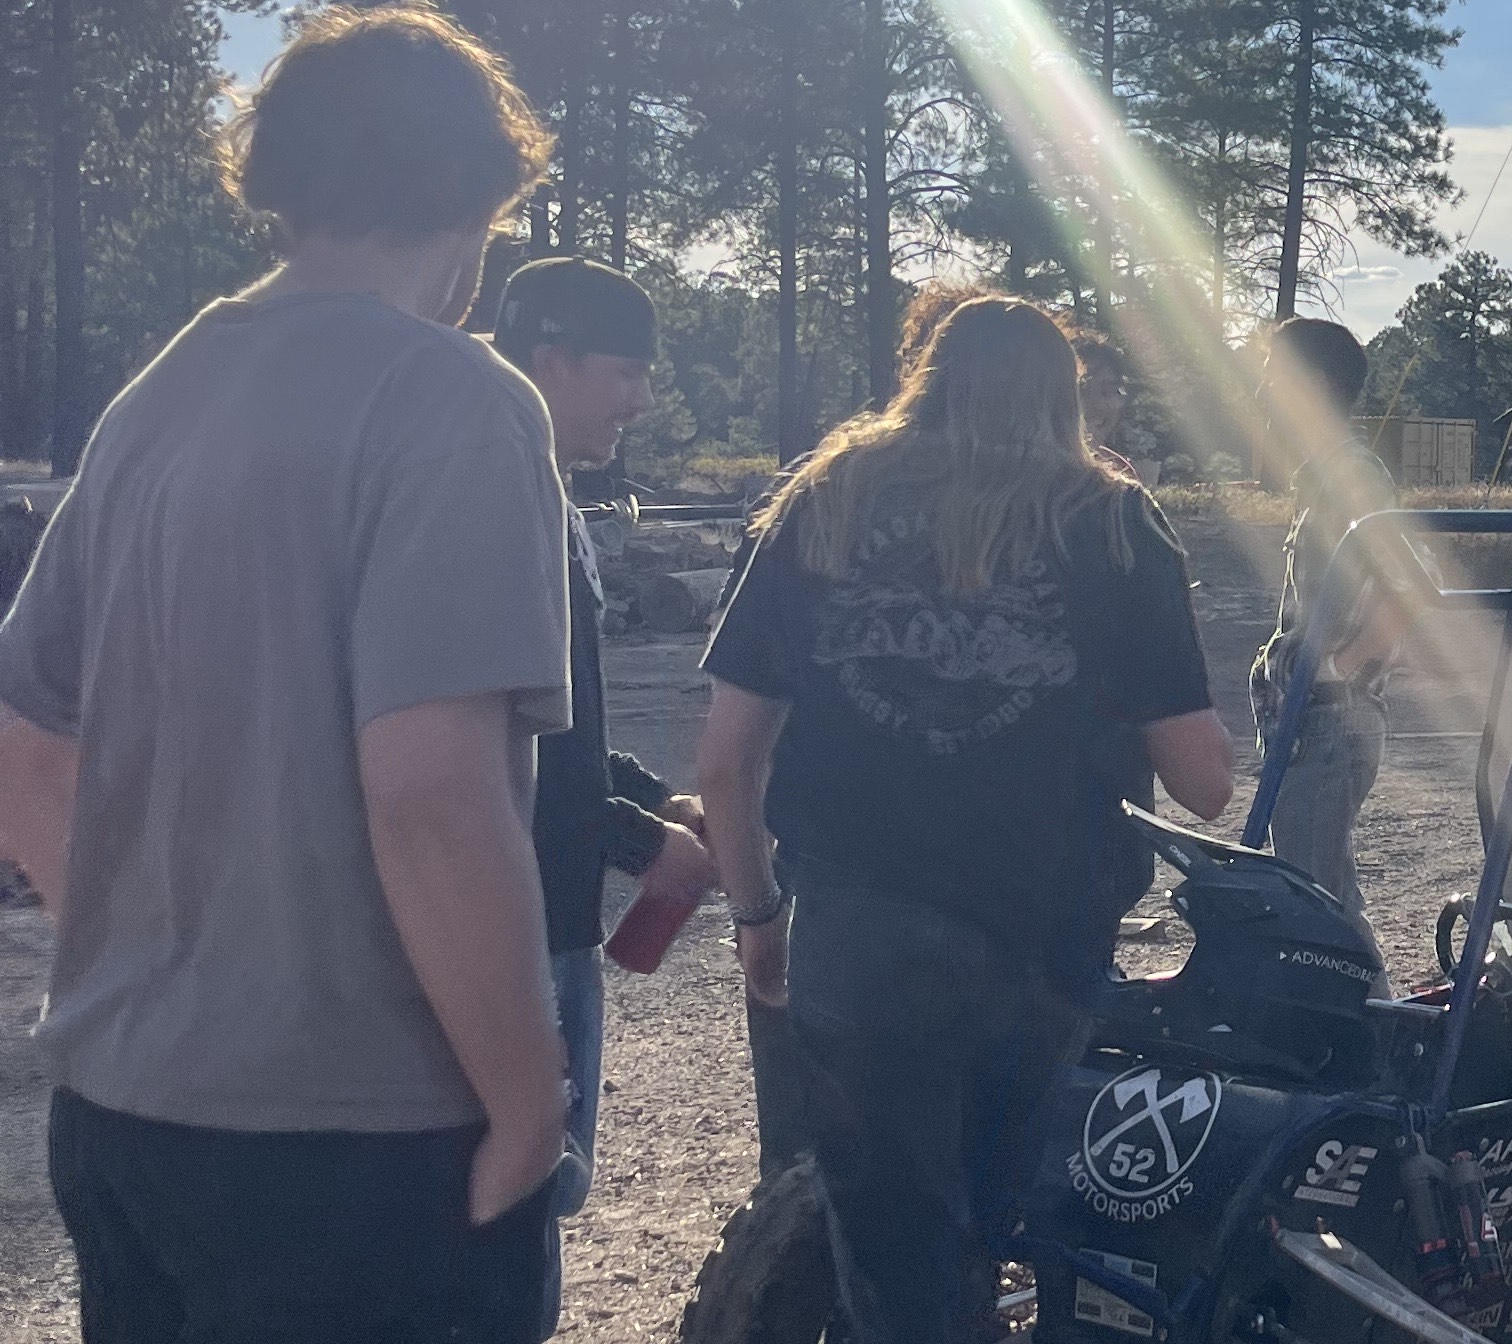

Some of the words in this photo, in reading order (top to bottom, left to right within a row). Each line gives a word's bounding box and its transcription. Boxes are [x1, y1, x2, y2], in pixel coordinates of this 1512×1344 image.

[1065, 1149, 1195, 1223] MOTORSPORTS
[1109, 1142, 1156, 1184] 52
[1305, 1139, 1379, 1193] SAE
